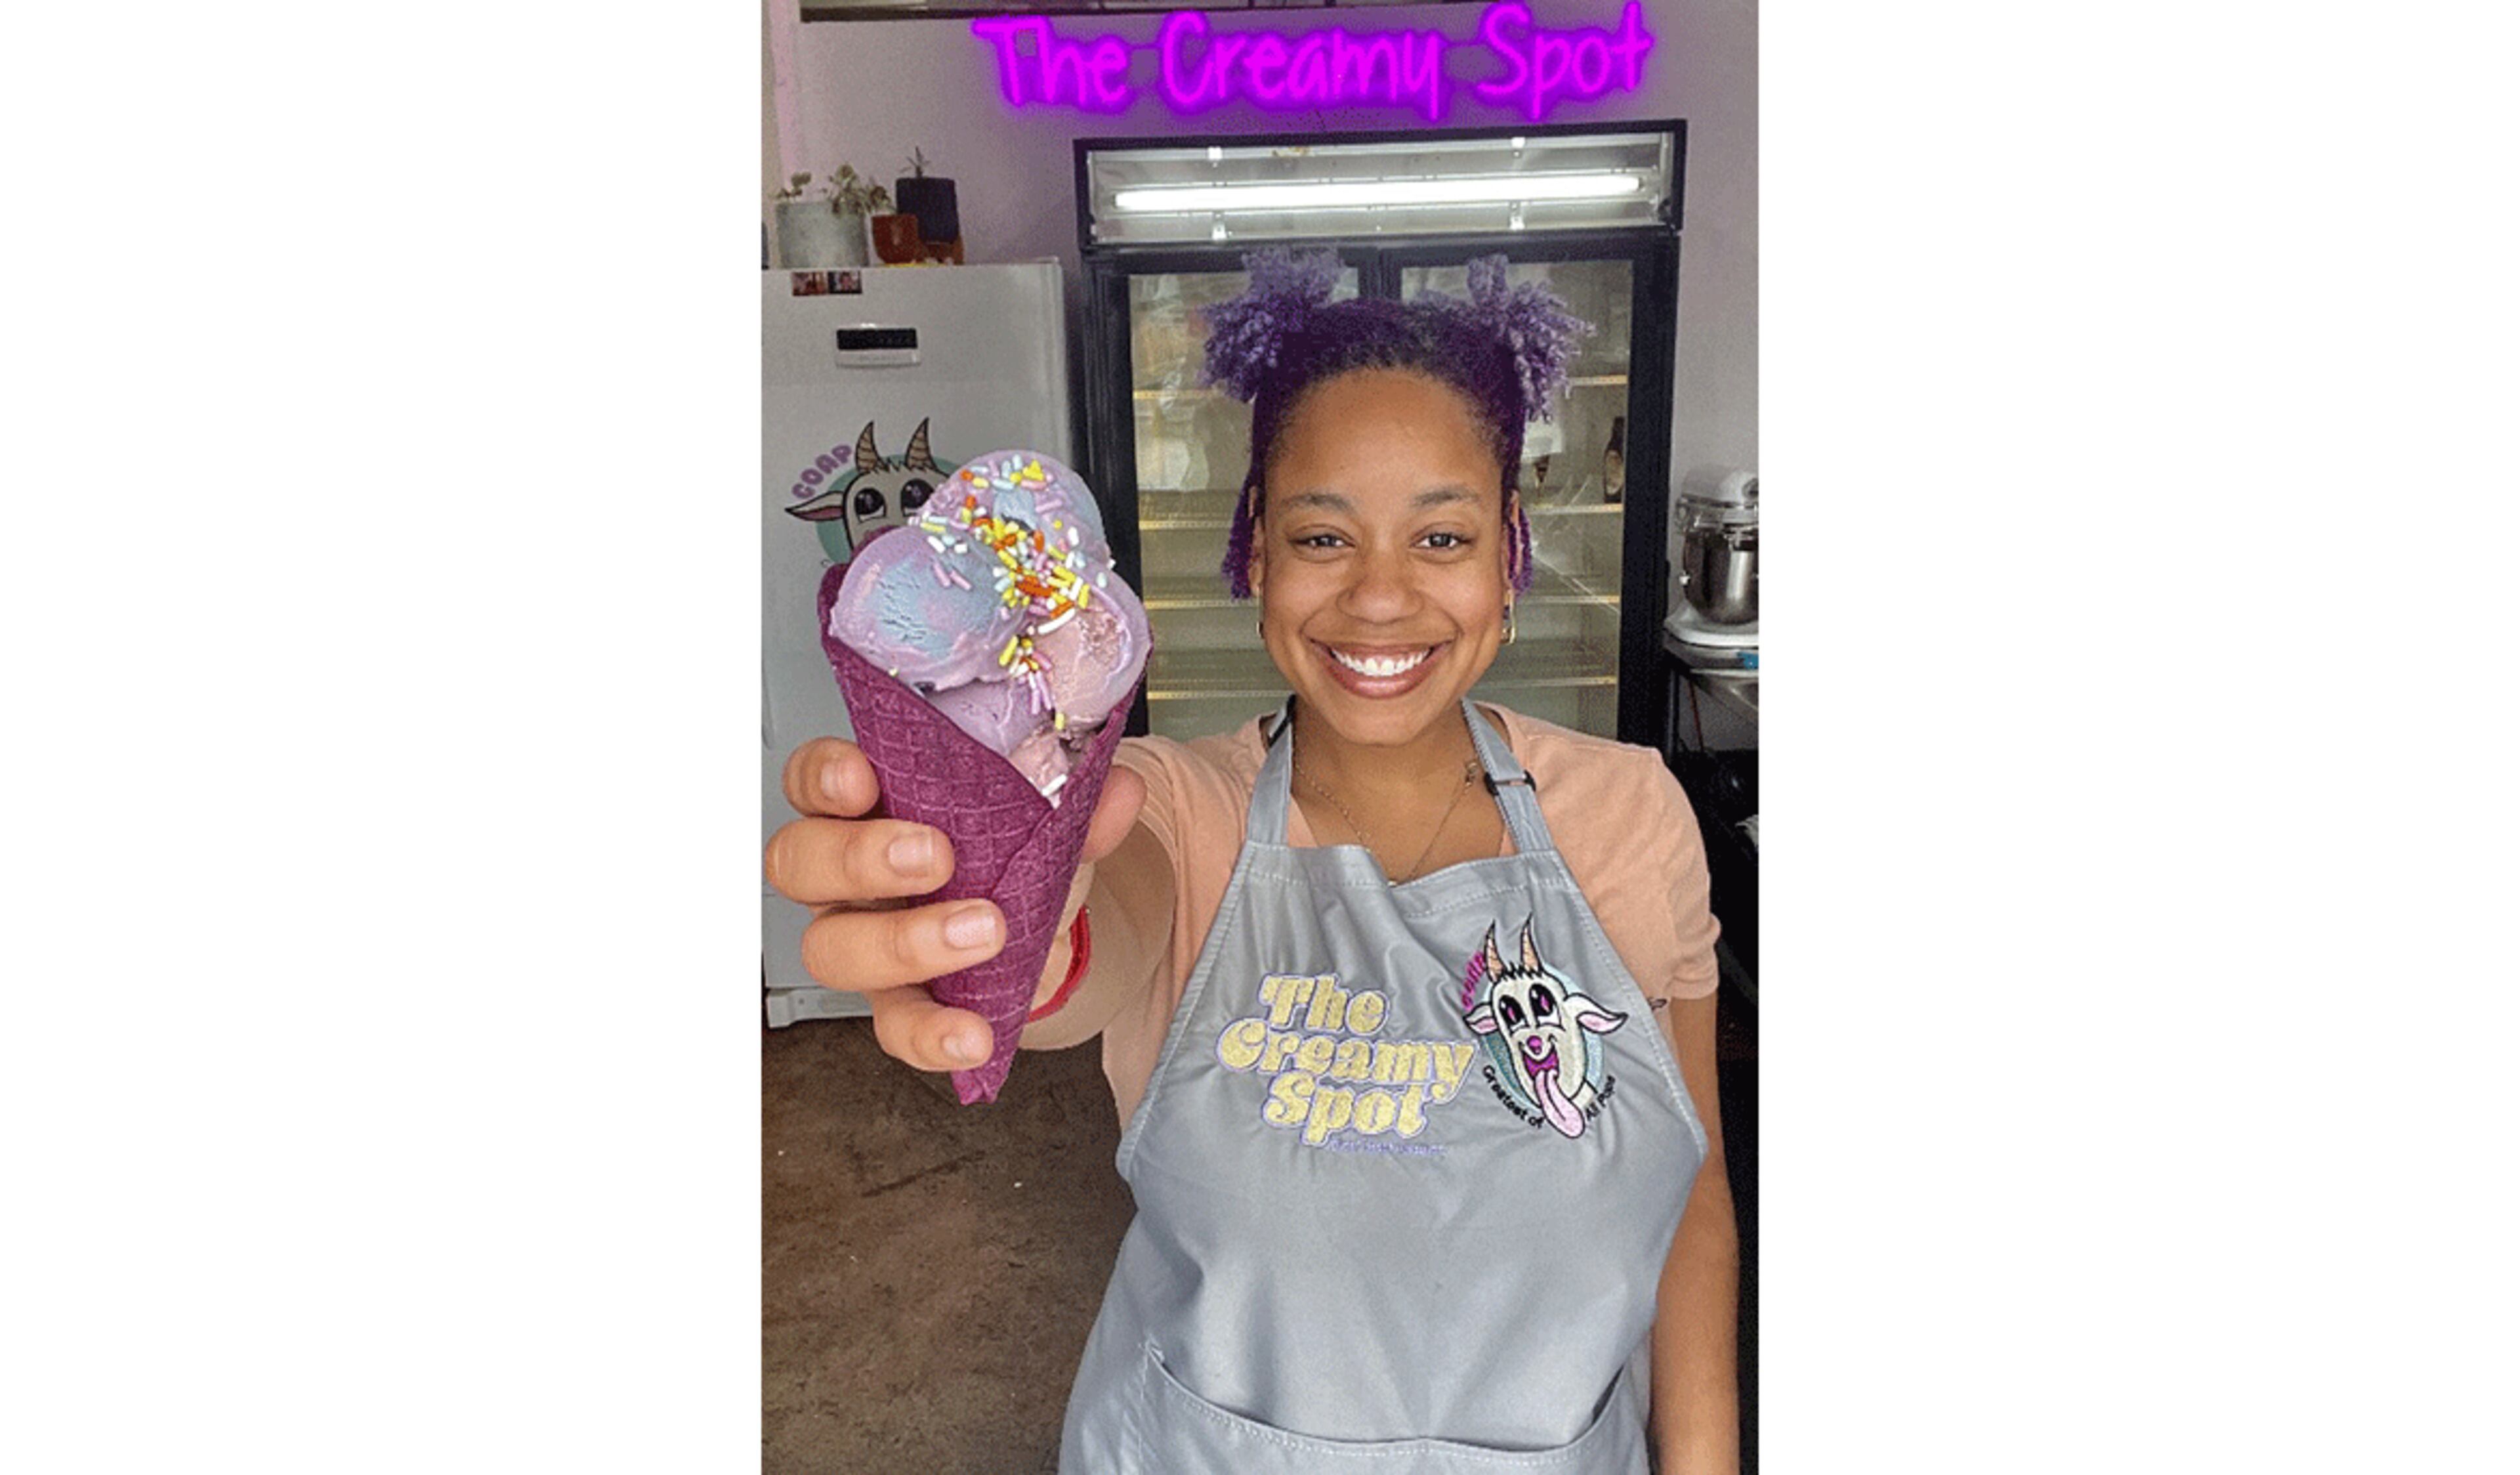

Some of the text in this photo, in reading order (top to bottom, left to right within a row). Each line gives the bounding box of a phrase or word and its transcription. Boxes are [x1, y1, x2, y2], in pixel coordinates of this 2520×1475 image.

[971, 1, 1654, 122] The Creamy Spot
[791, 444, 852, 499] GOAP
[1259, 973, 1391, 1036] The
[1217, 1017, 1479, 1105] Creamy
[1482, 1065, 1528, 1121] Greatest
[1261, 1069, 1428, 1146] Spot
